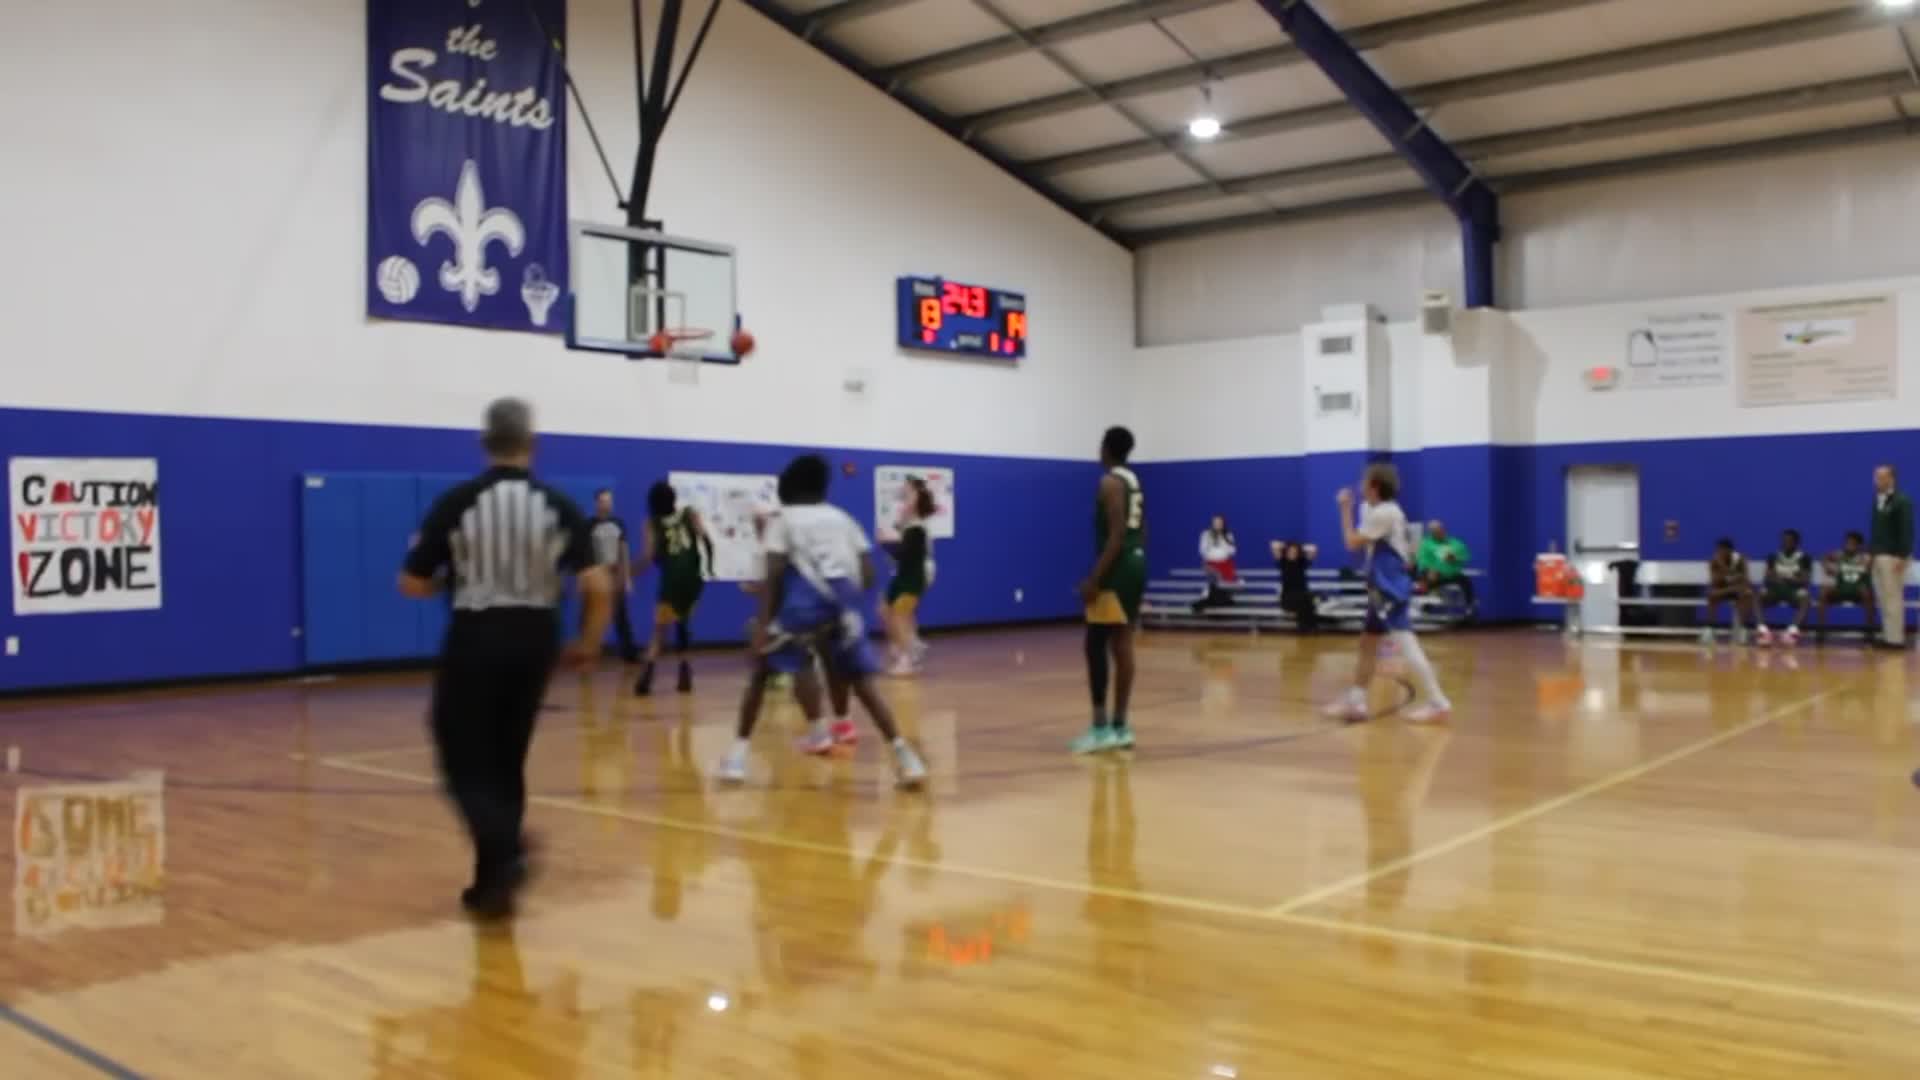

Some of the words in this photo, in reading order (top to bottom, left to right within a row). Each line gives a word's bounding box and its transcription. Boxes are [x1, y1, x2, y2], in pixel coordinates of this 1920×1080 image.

[446, 24, 497, 59] the
[380, 47, 555, 129] Saints
[22, 474, 158, 507] CAUTION
[18, 508, 155, 545] VICTORY
